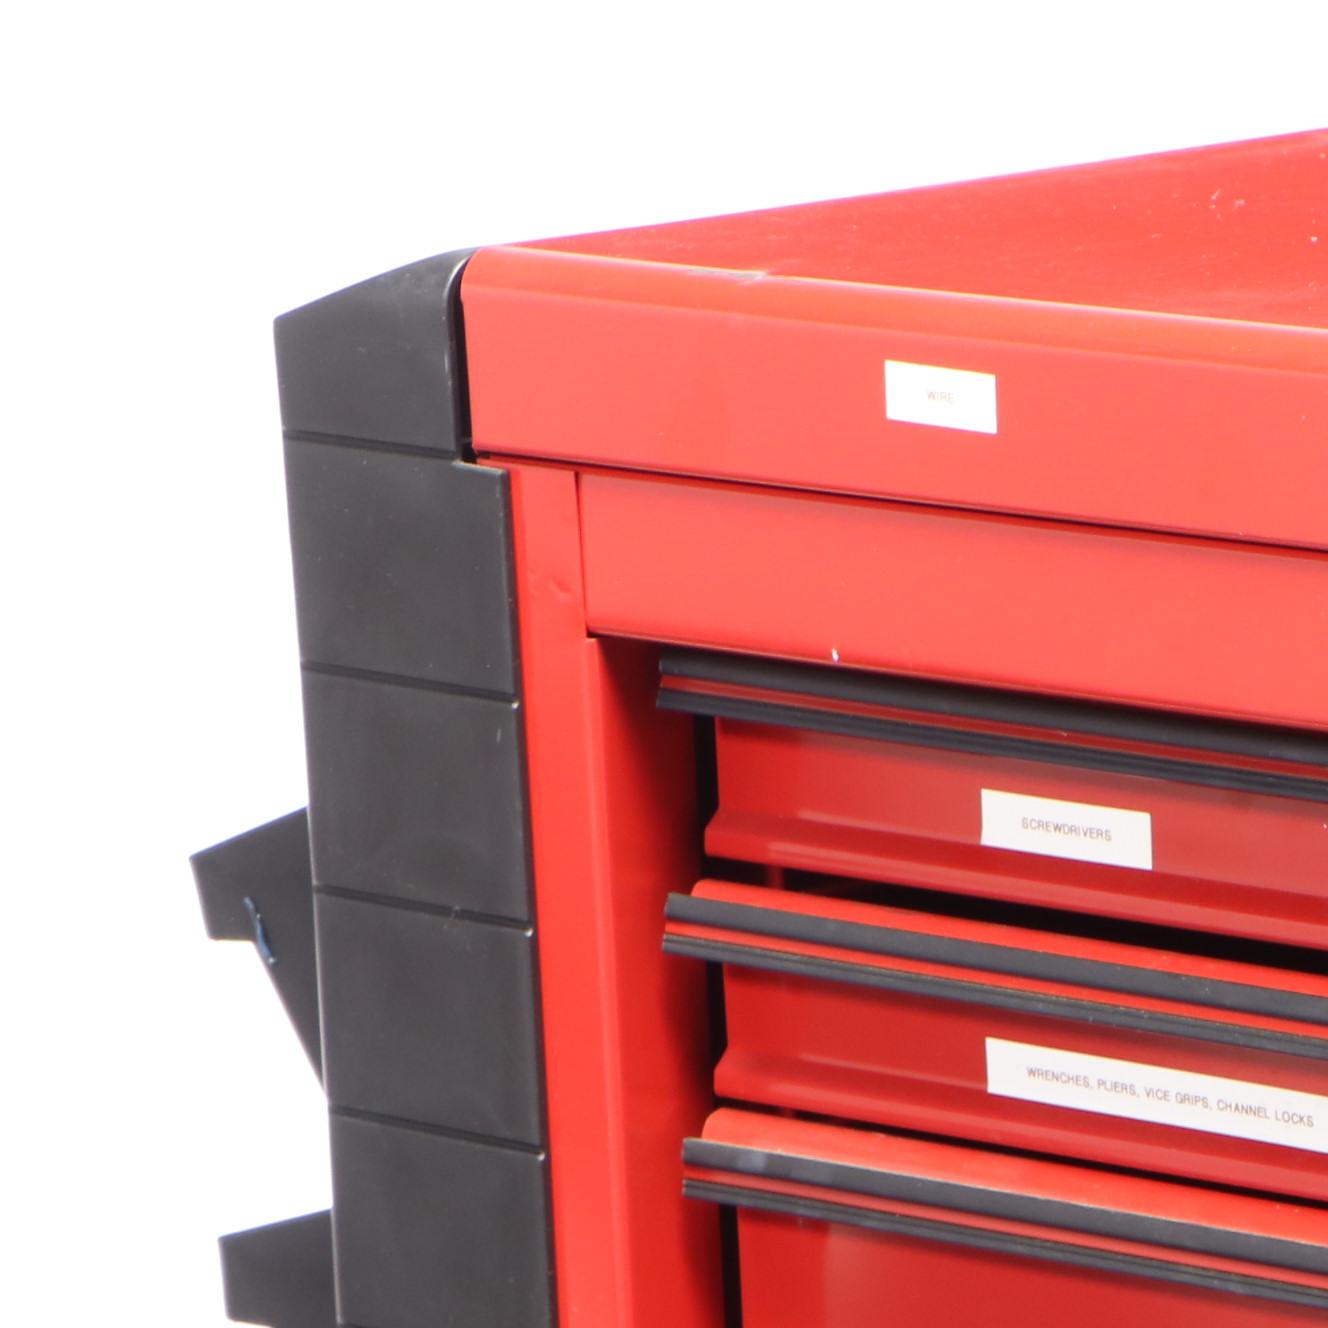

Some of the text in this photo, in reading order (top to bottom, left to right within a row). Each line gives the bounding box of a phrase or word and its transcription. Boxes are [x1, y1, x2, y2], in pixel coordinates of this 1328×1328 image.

[926, 390, 955, 403] WIRE
[1021, 816, 1112, 842] SCREWDRIVERS
[1026, 1066, 1315, 1127] WRENCHES, PLIERS, VICE GRIPS, CHANNEL LOCKS
